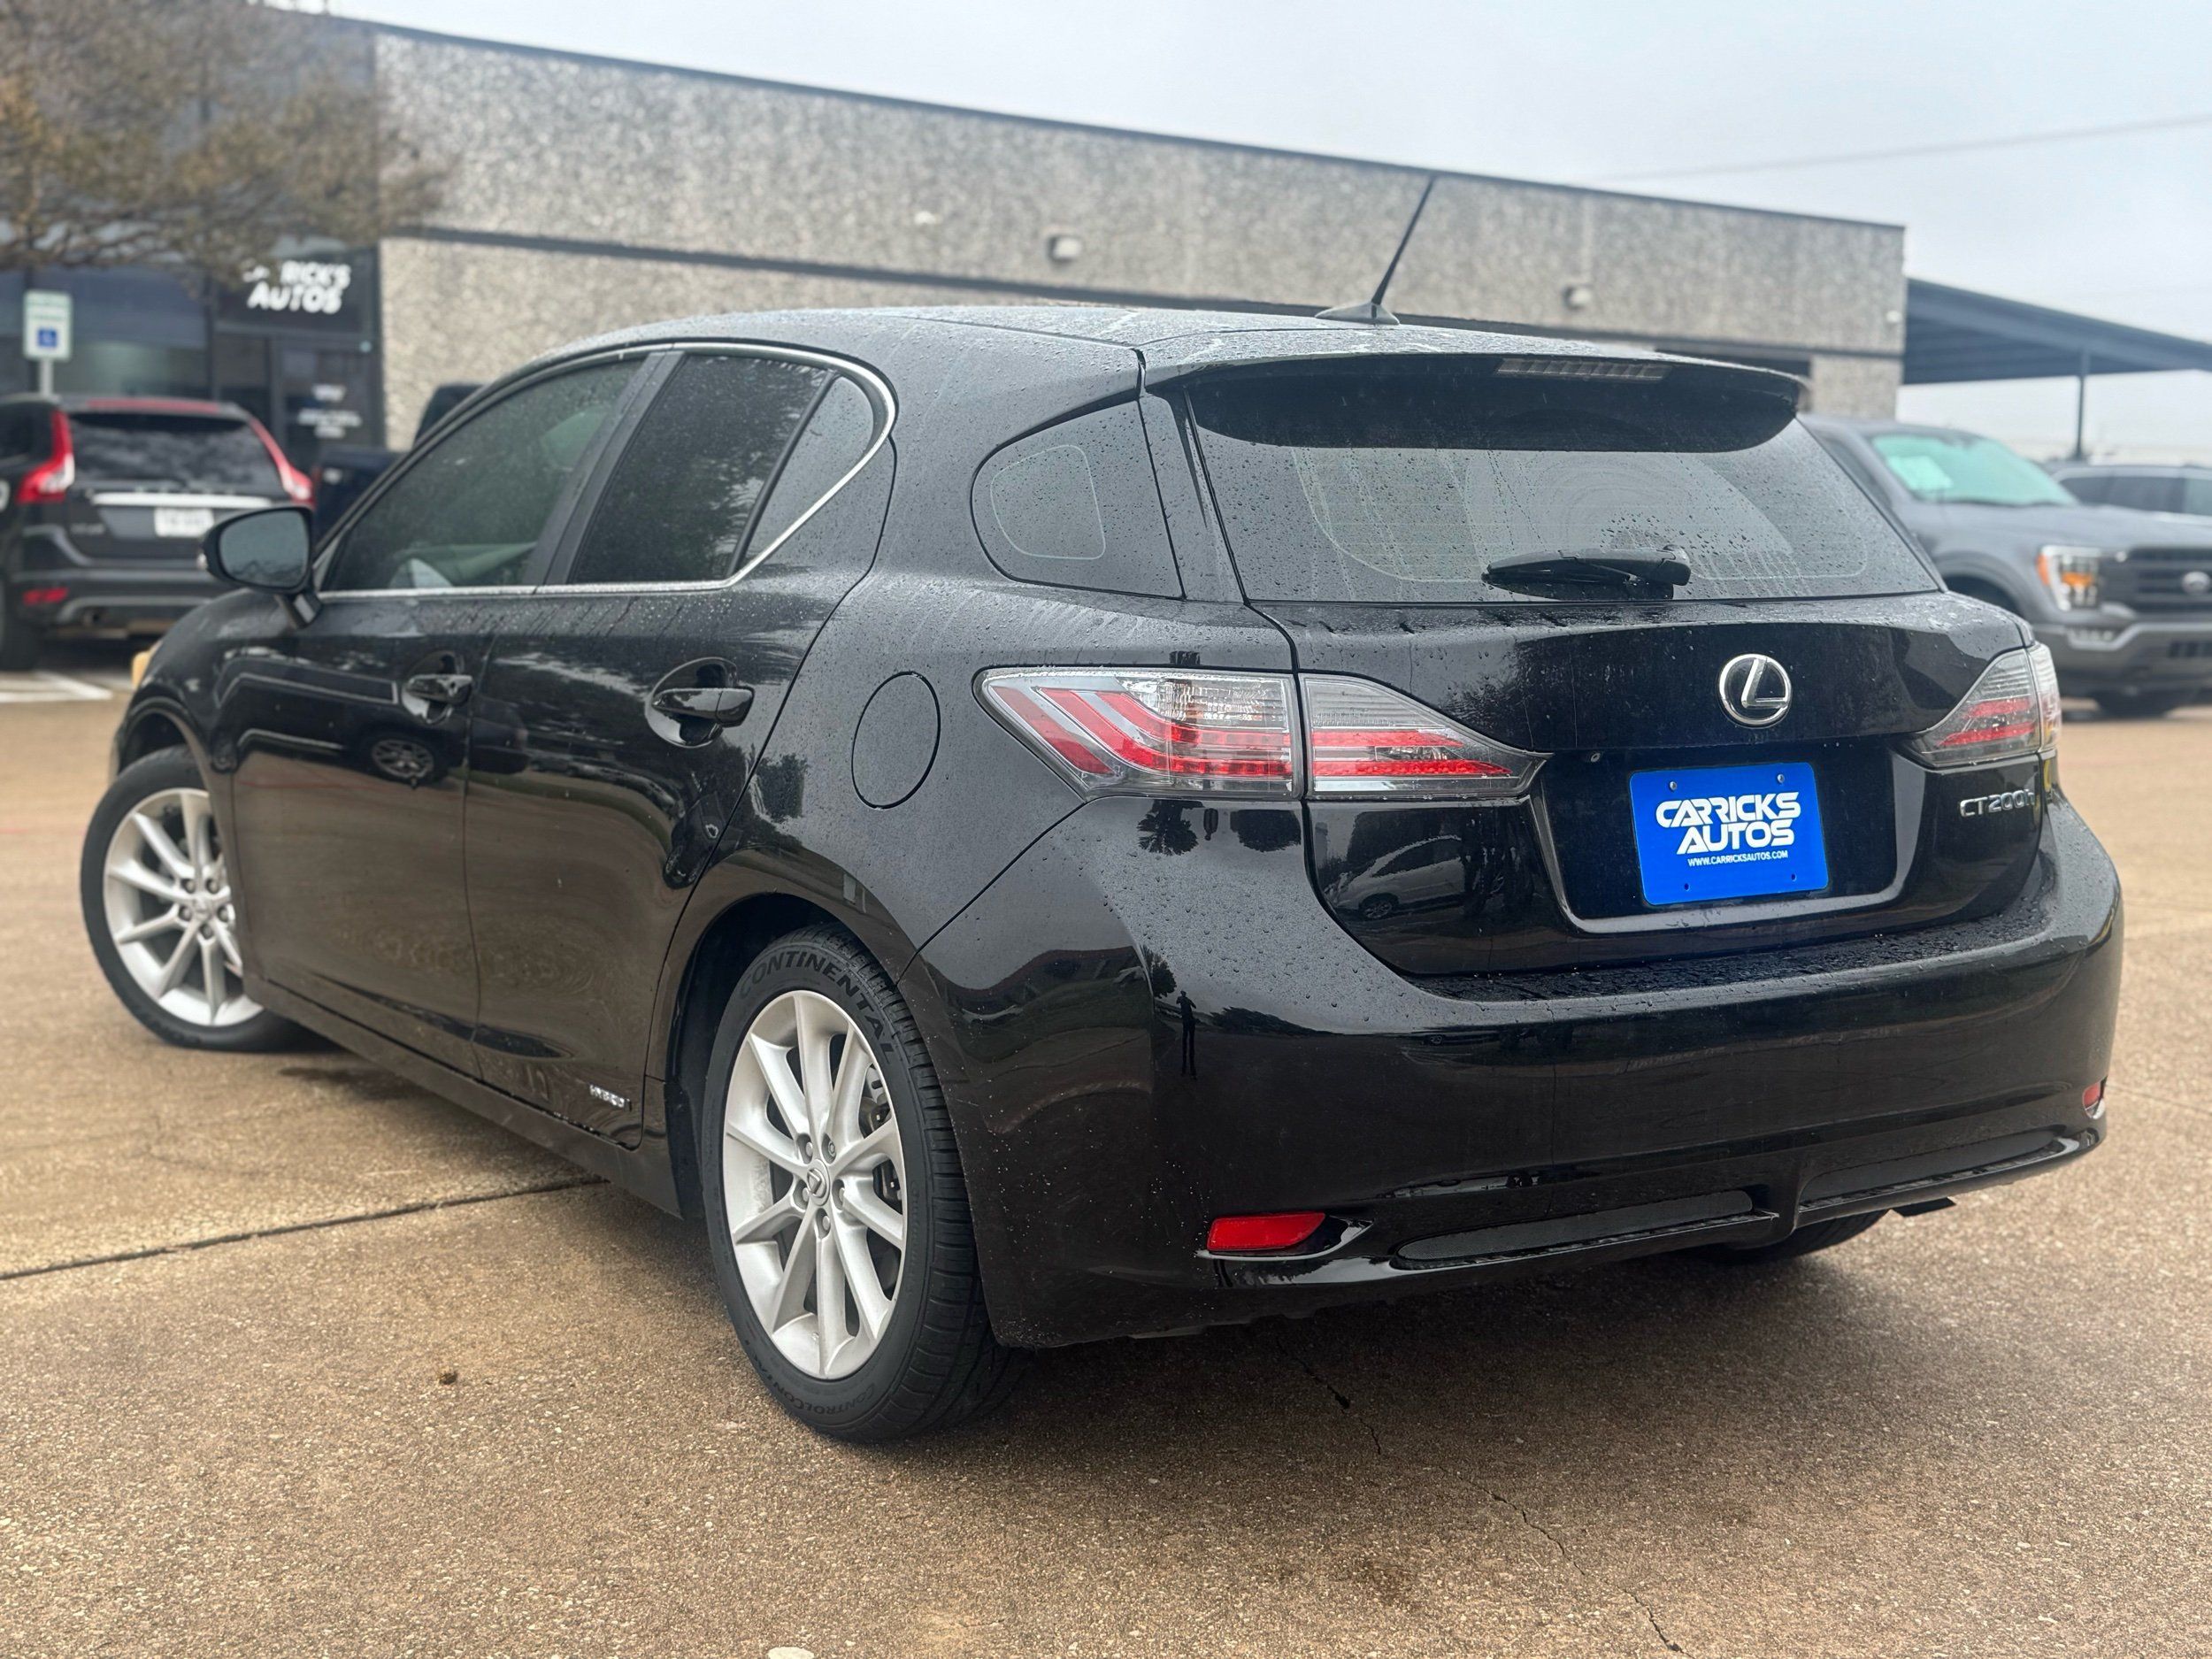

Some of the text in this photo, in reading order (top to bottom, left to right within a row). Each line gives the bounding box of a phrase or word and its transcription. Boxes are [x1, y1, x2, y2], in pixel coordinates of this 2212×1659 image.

[247, 280, 342, 314] AUTOS
[1655, 792, 1801, 828] CARRICKS
[1677, 818, 1795, 855] AUTOS
[1687, 850, 1788, 867] WWW.CARRICKSAUTOS.COM
[739, 949, 894, 1064] CONTINENTAL
